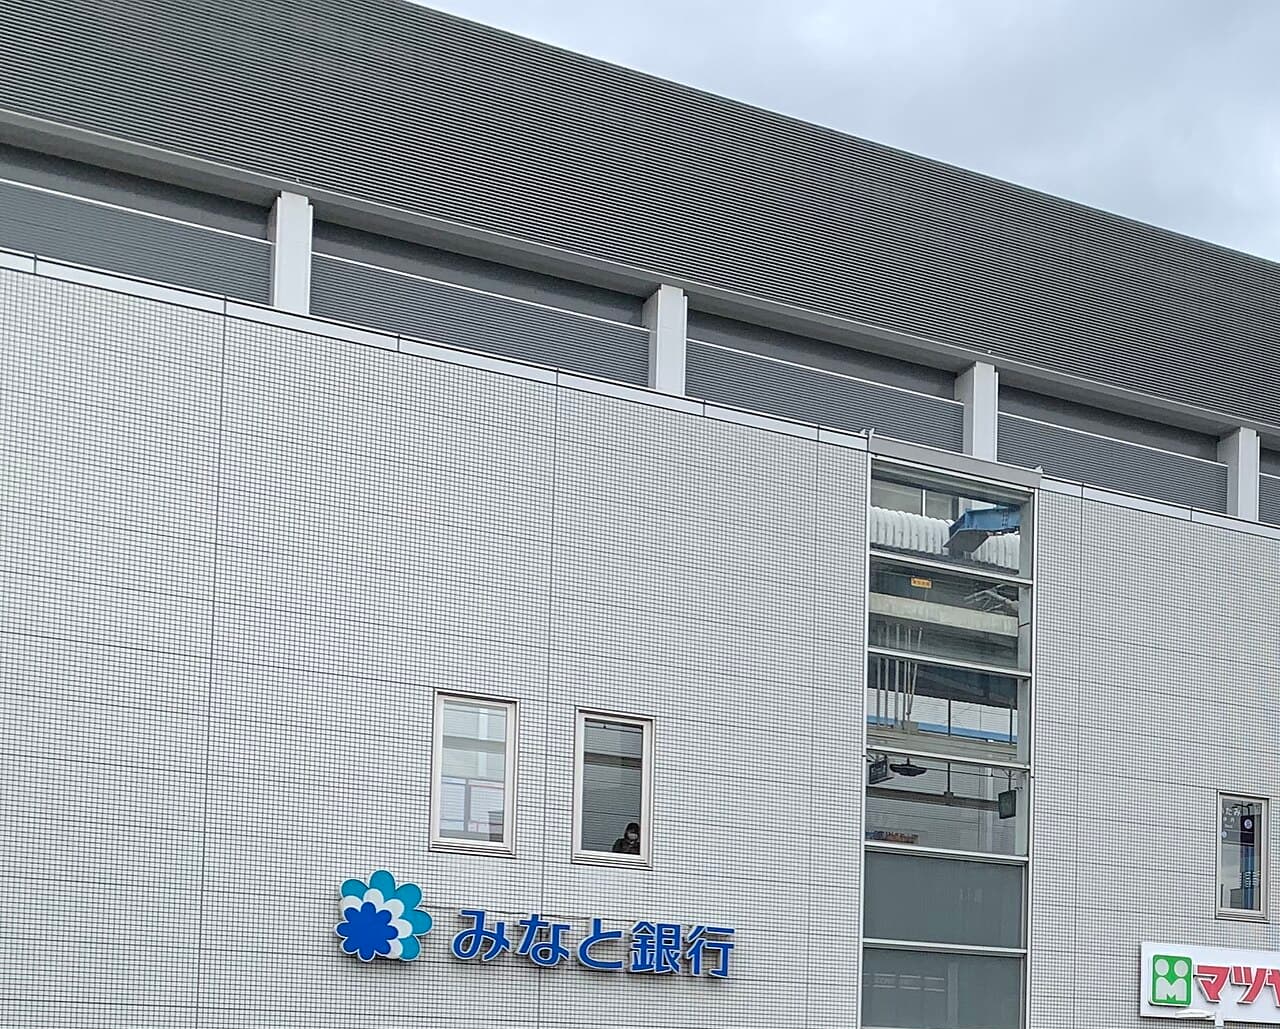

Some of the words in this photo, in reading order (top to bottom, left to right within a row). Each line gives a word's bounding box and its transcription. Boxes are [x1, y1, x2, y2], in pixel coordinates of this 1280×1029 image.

[451, 907, 736, 979] みなと銀行
